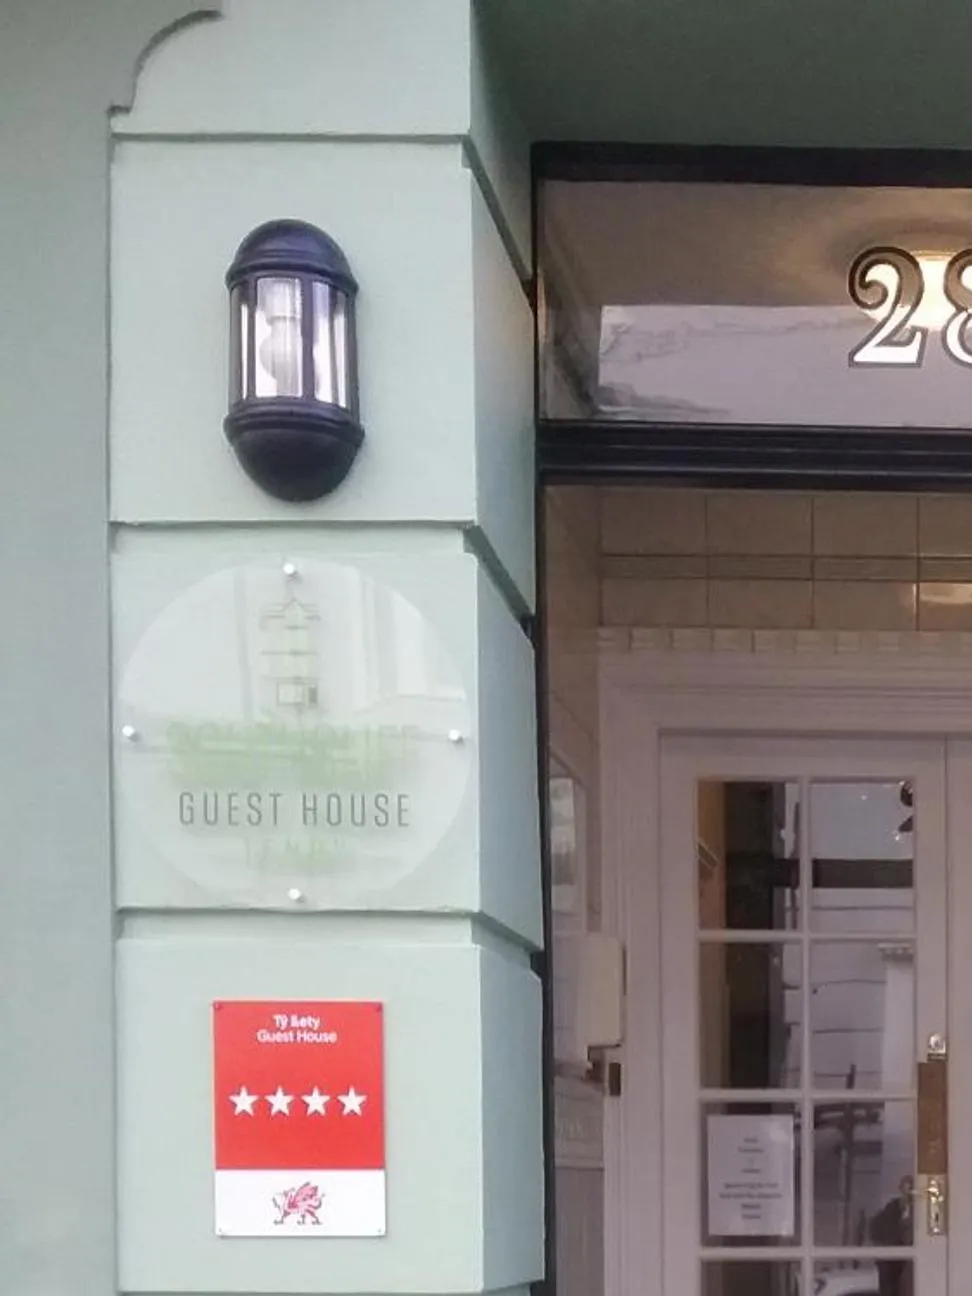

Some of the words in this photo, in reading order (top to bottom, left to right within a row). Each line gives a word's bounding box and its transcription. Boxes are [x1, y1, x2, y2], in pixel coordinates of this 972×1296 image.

[178, 791, 283, 827] GUEST
[301, 794, 411, 828] HOUSE
[257, 1029, 294, 1044] Guest
[296, 1030, 338, 1044] House
